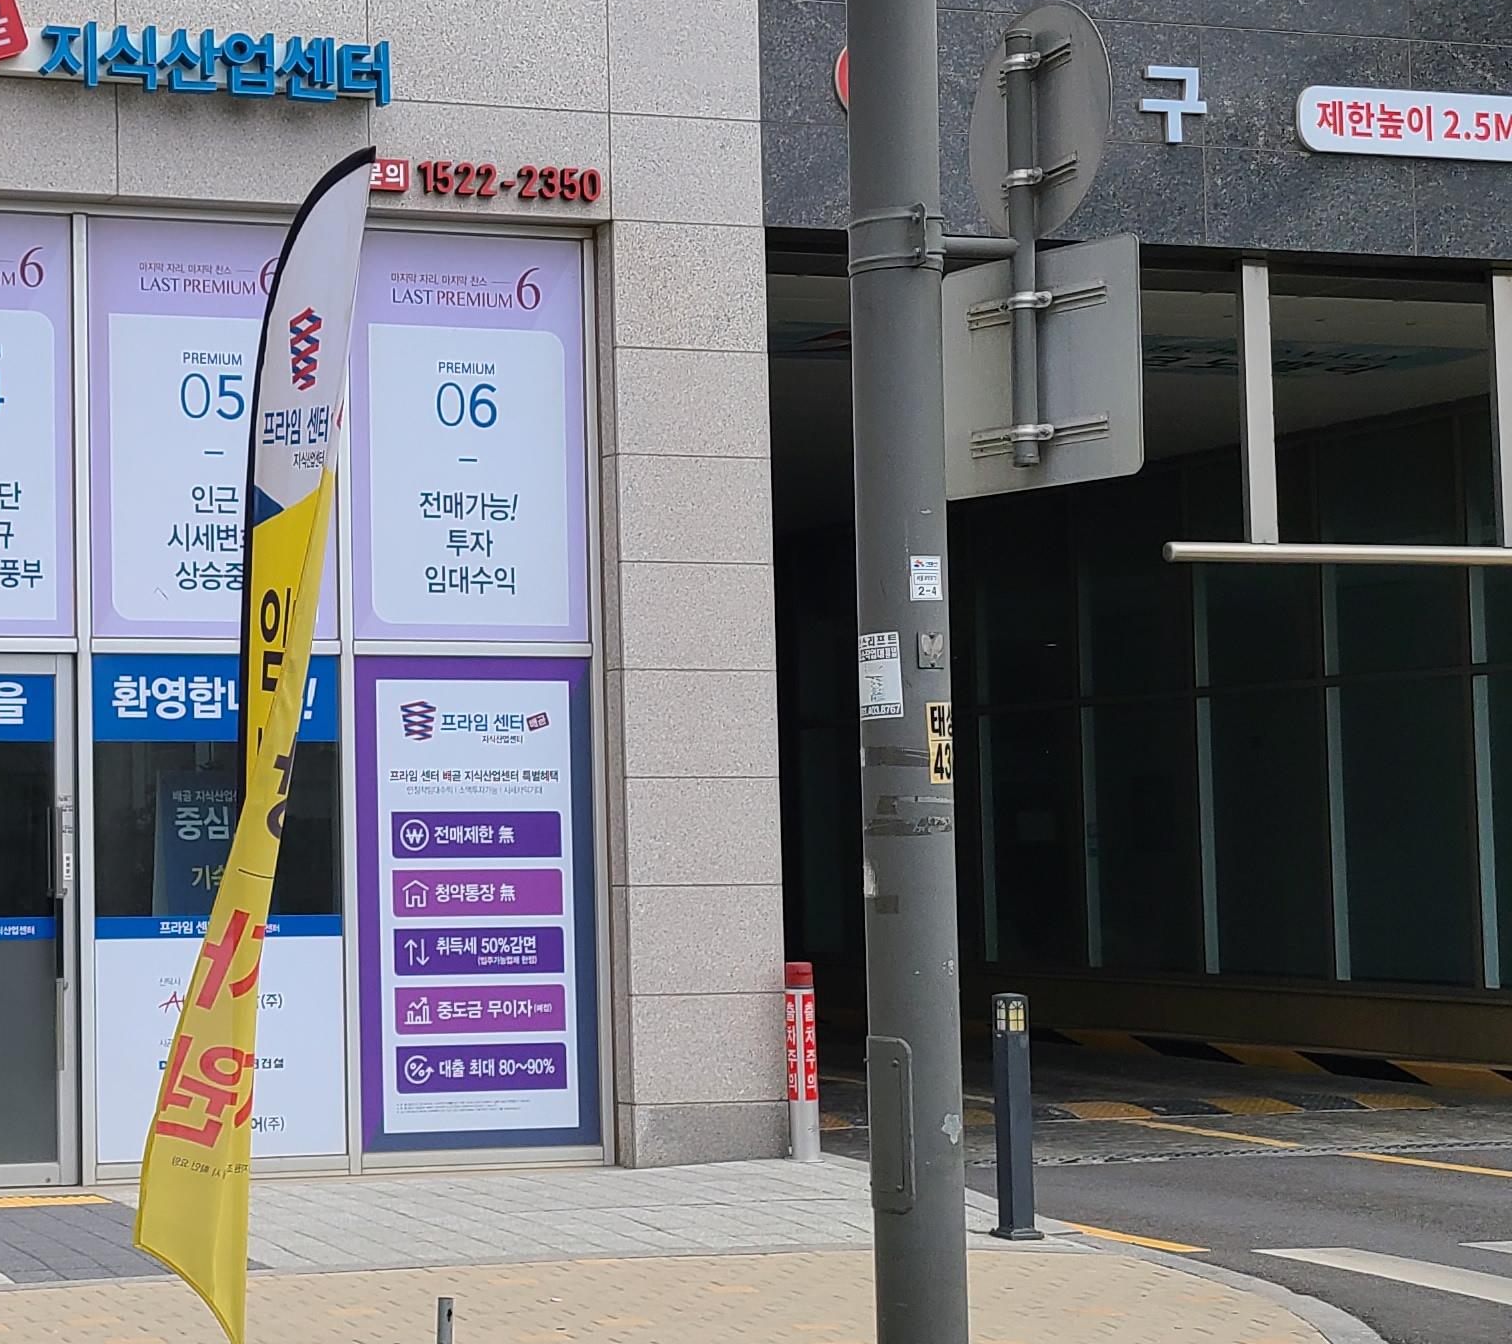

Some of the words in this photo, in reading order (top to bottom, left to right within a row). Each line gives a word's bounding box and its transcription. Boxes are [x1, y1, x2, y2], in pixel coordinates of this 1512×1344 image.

[40, 21, 393, 108] 지식산업센터
[1316, 100, 1433, 142] 제한높이
[417, 159, 602, 203] 1522-2350
[19, 246, 44, 288] 6
[140, 276, 180, 292] LAST
[183, 279, 256, 296] PREMIUM
[392, 288, 433, 305] LAST
[437, 290, 513, 309] PREMIUM
[516, 267, 541, 311] 6
[183, 352, 242, 366] PREMIUM
[438, 361, 495, 375] PREMIUM
[180, 373, 245, 420] 05
[436, 382, 498, 428] 06
[262, 408, 301, 445] 프라임
[306, 405, 329, 443] 센터
[191, 485, 239, 514] 인근
[419, 490, 519, 521] 전매가능!
[167, 523, 246, 552] 시세변
[446, 529, 494, 558] 투자
[424, 565, 516, 595] 임대수익
[918, 586, 937, 597] 2-4
[441, 714, 488, 732] 프라임
[494, 713, 524, 732] 센터
[389, 770, 418, 782] 프라임
[421, 770, 439, 781] 센터
[465, 770, 519, 782] 지식산업센터
[195, 789, 237, 802] 지식산업
[174, 806, 230, 841] 중심
[434, 825, 494, 844] 전매제한
[435, 884, 495, 902] 청약통장
[159, 921, 192, 934] 프라임
[196, 921, 208, 934] 센
[436, 936, 477, 955] 취득세
[481, 936, 537, 954] 50%감면
[437, 1001, 482, 1020] 중도금
[487, 1000, 533, 1018] 무이자
[439, 1059, 465, 1078] 대출
[469, 1059, 495, 1077] 최대
[499, 1058, 555, 1076] 80~90%
